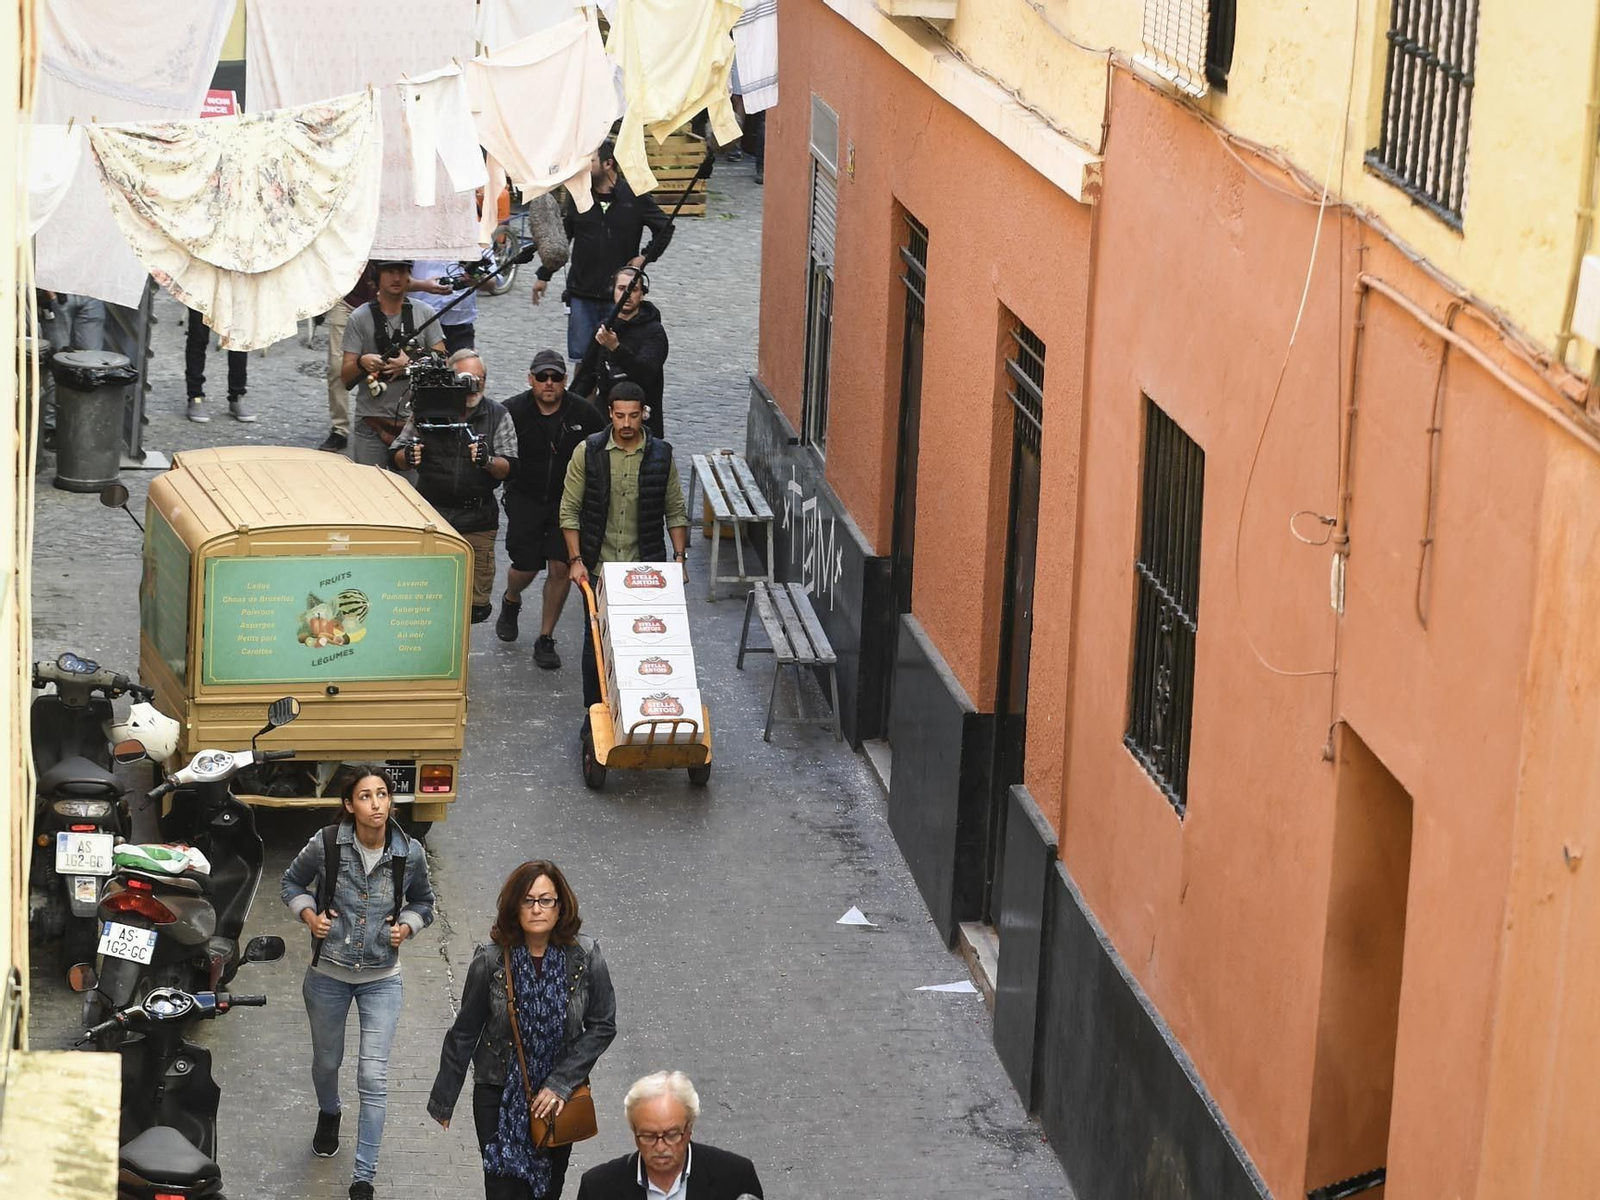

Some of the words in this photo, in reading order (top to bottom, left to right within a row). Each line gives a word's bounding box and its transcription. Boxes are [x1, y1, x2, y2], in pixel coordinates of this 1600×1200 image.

[319, 571, 353, 588] FRUITS
[397, 579, 428, 587] Lavande
[392, 606, 431, 614] Aubergine
[240, 622, 276, 630] Asperges
[390, 618, 432, 626] Concombre
[398, 644, 421, 652] Olives
[311, 648, 355, 667] LÉGUMES
[77, 840, 92, 854] AS
[106, 939, 147, 960] 1G2-GC
